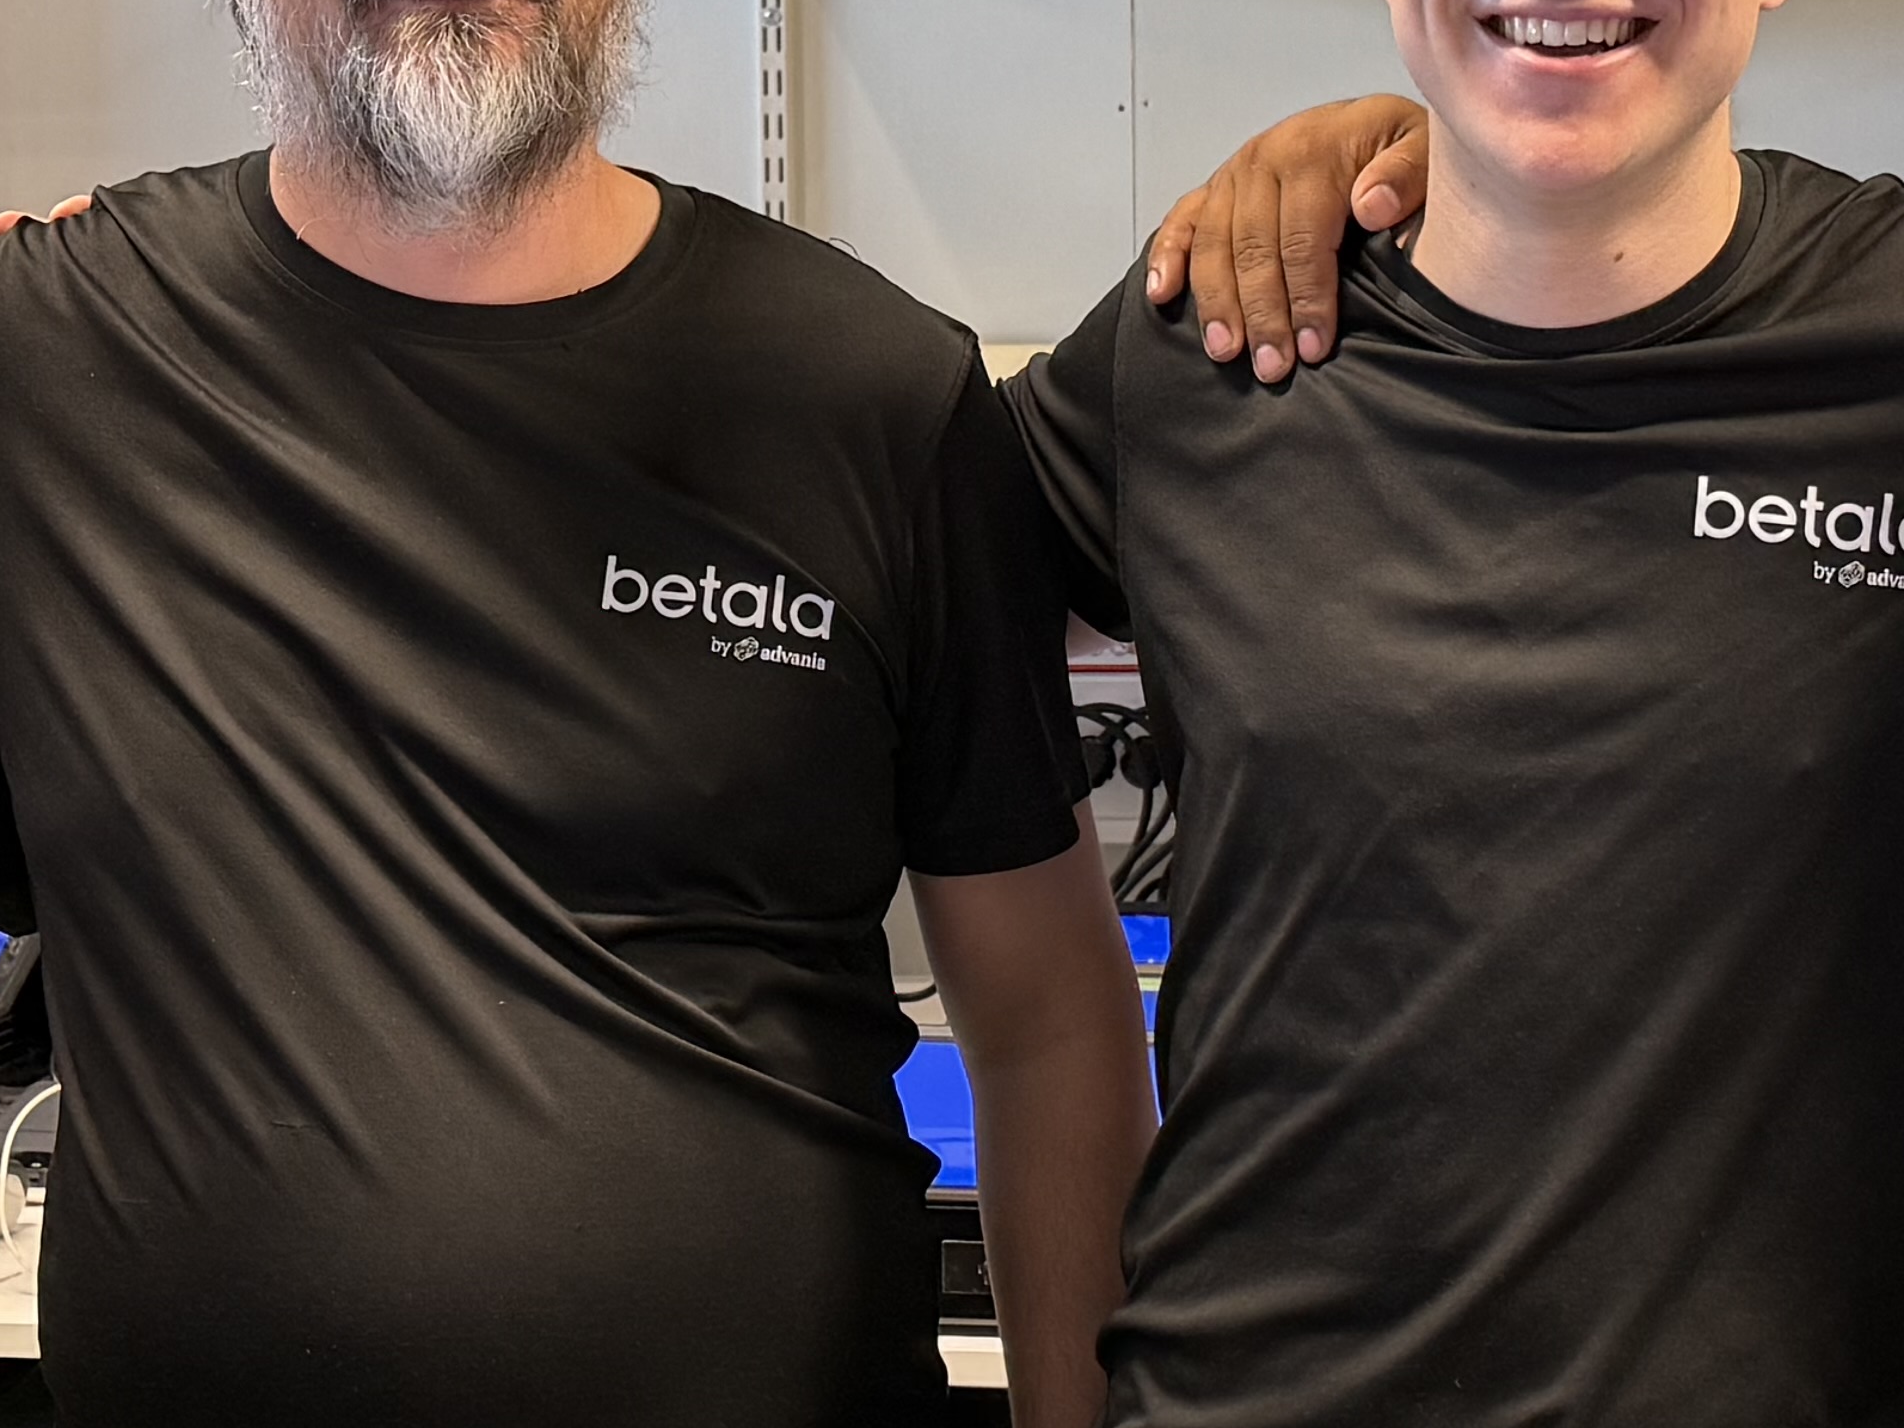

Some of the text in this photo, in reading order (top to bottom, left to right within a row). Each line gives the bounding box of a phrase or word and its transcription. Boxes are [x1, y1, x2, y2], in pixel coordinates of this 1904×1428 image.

[1813, 561, 1835, 584] by
[601, 554, 835, 641] betala
[711, 636, 826, 670] by advania
